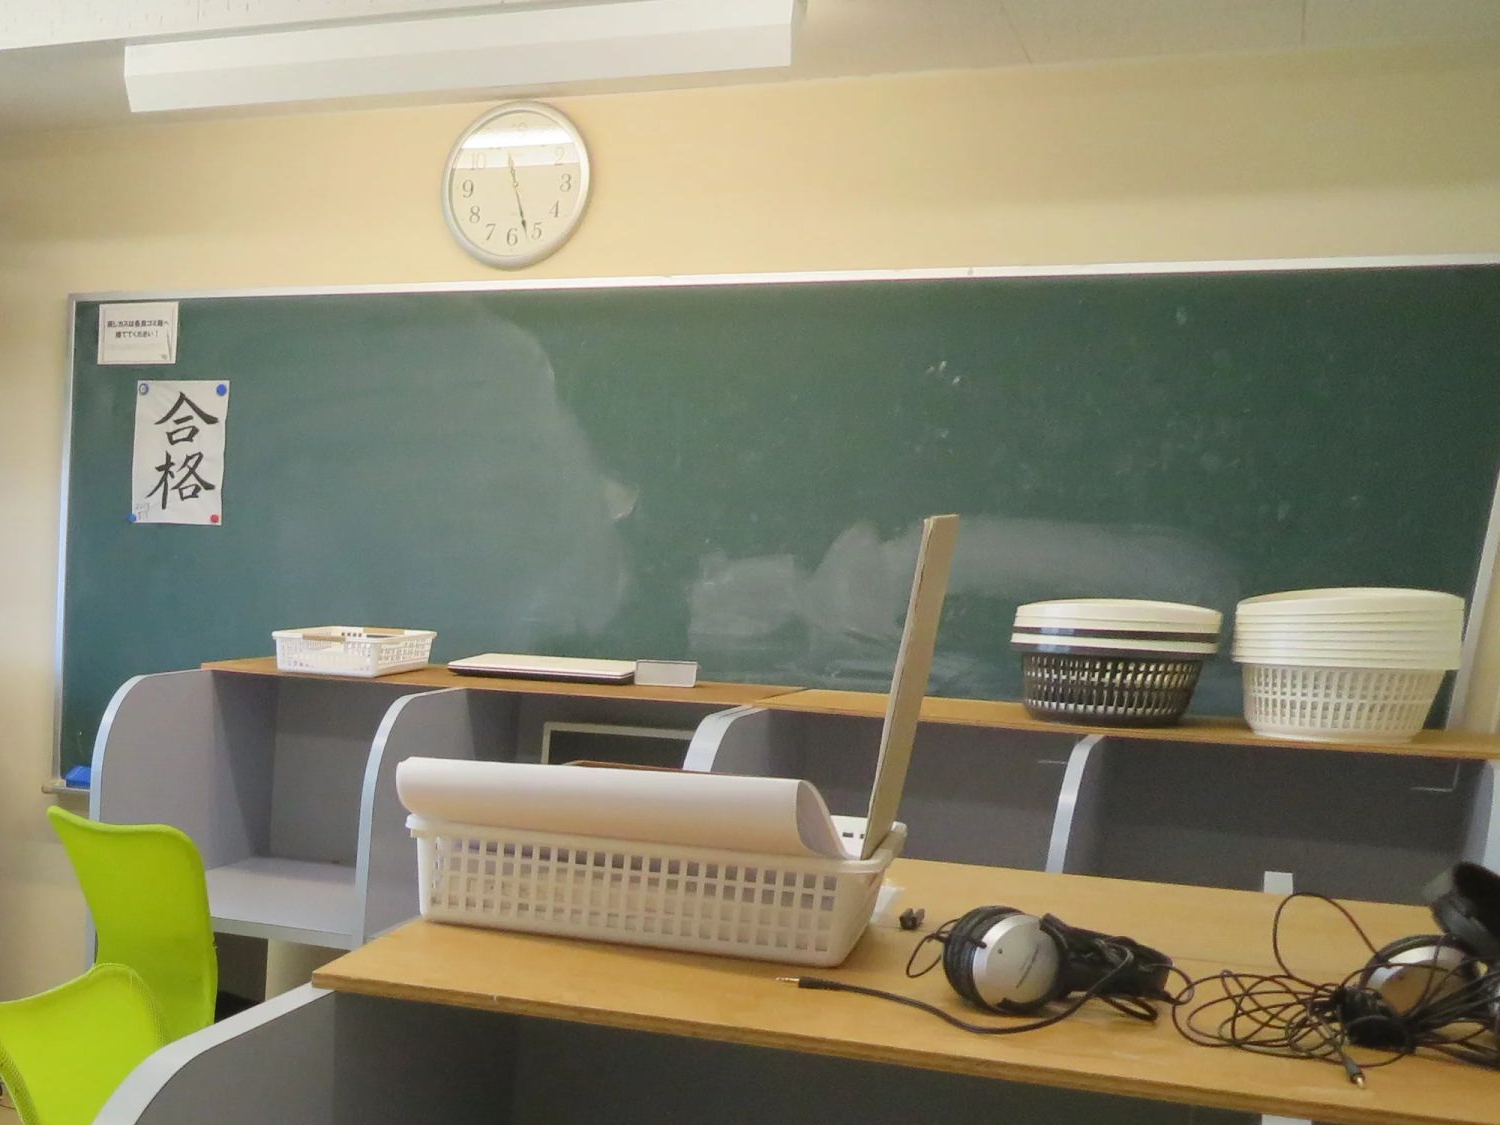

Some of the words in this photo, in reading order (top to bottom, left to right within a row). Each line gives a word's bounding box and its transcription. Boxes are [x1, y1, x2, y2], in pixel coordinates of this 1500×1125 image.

[462, 179, 475, 198] 9
[559, 173, 572, 192] 3
[469, 206, 481, 224] 8
[549, 200, 560, 218] 4
[485, 223, 496, 241] 7
[506, 227, 518, 246] 6
[531, 222, 543, 240] 5
[146, 391, 219, 510] 合格
